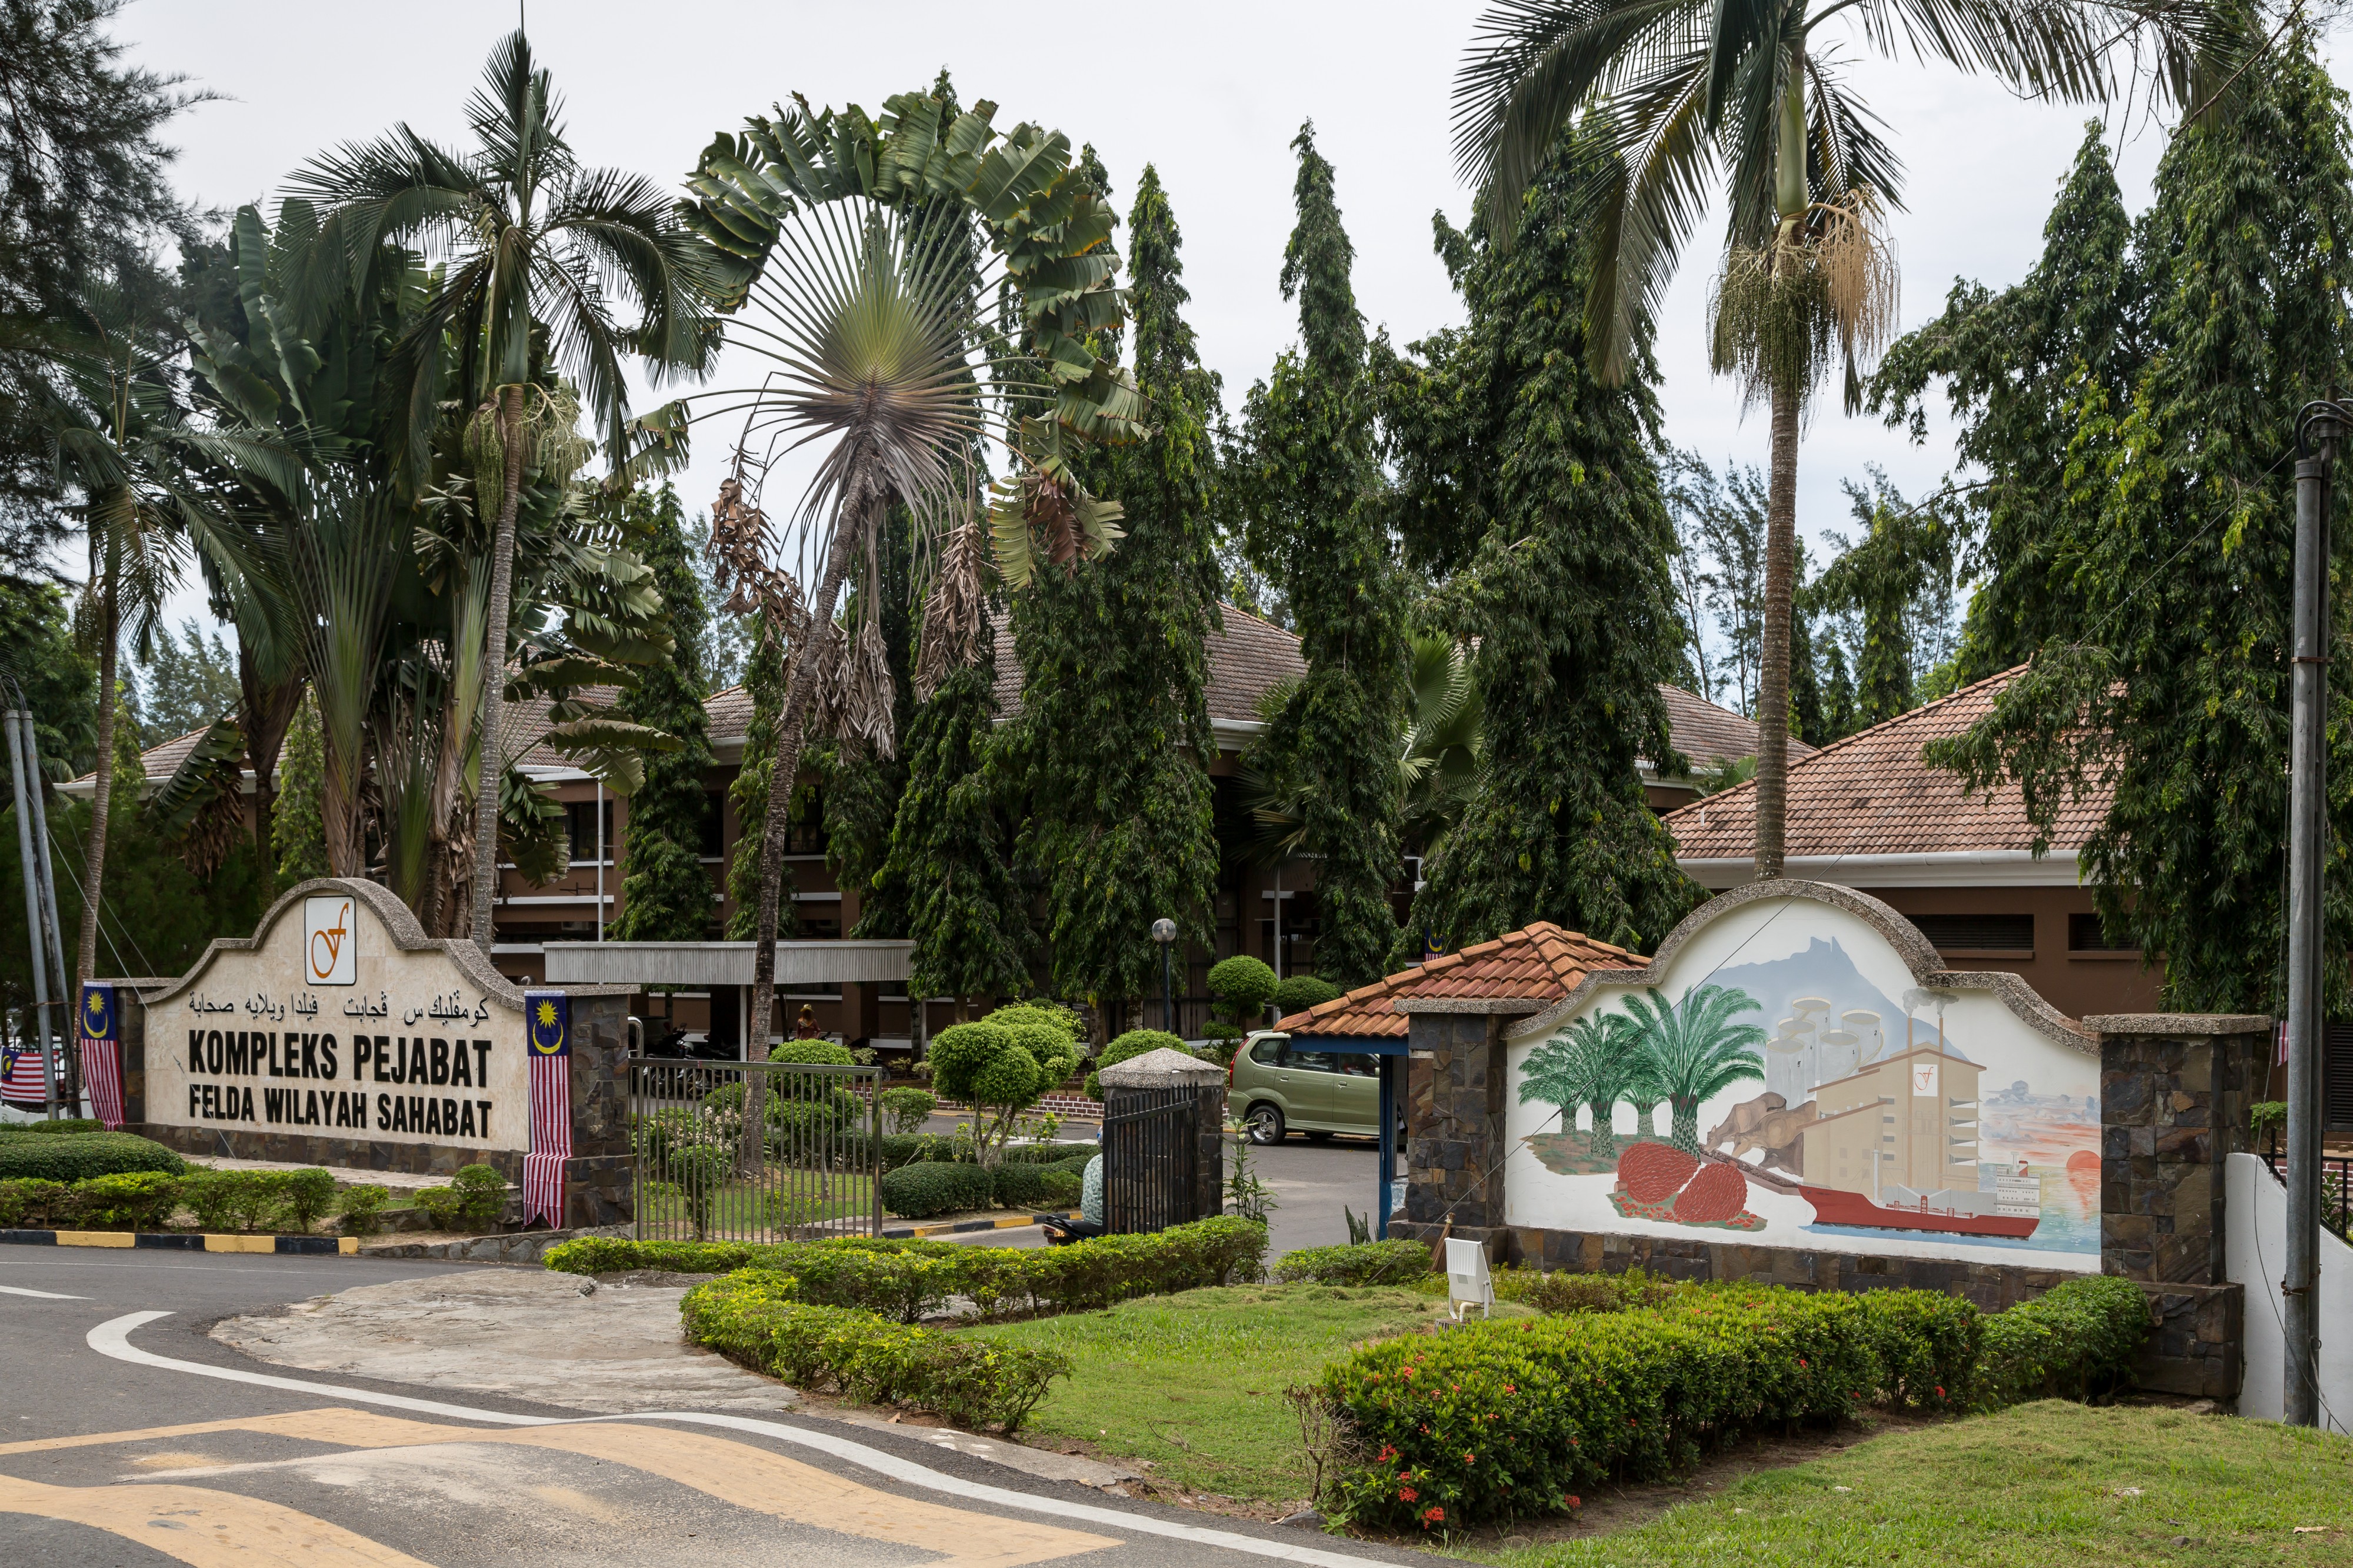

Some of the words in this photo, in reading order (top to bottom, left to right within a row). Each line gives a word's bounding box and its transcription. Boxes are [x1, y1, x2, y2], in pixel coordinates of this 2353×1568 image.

[188, 1029, 338, 1080] KOMPLEKS
[353, 1034, 492, 1088] PEJABAT
[189, 1083, 256, 1122] FELDA
[263, 1087, 367, 1129] WILAYAH
[376, 1092, 493, 1139] SAHABAT
